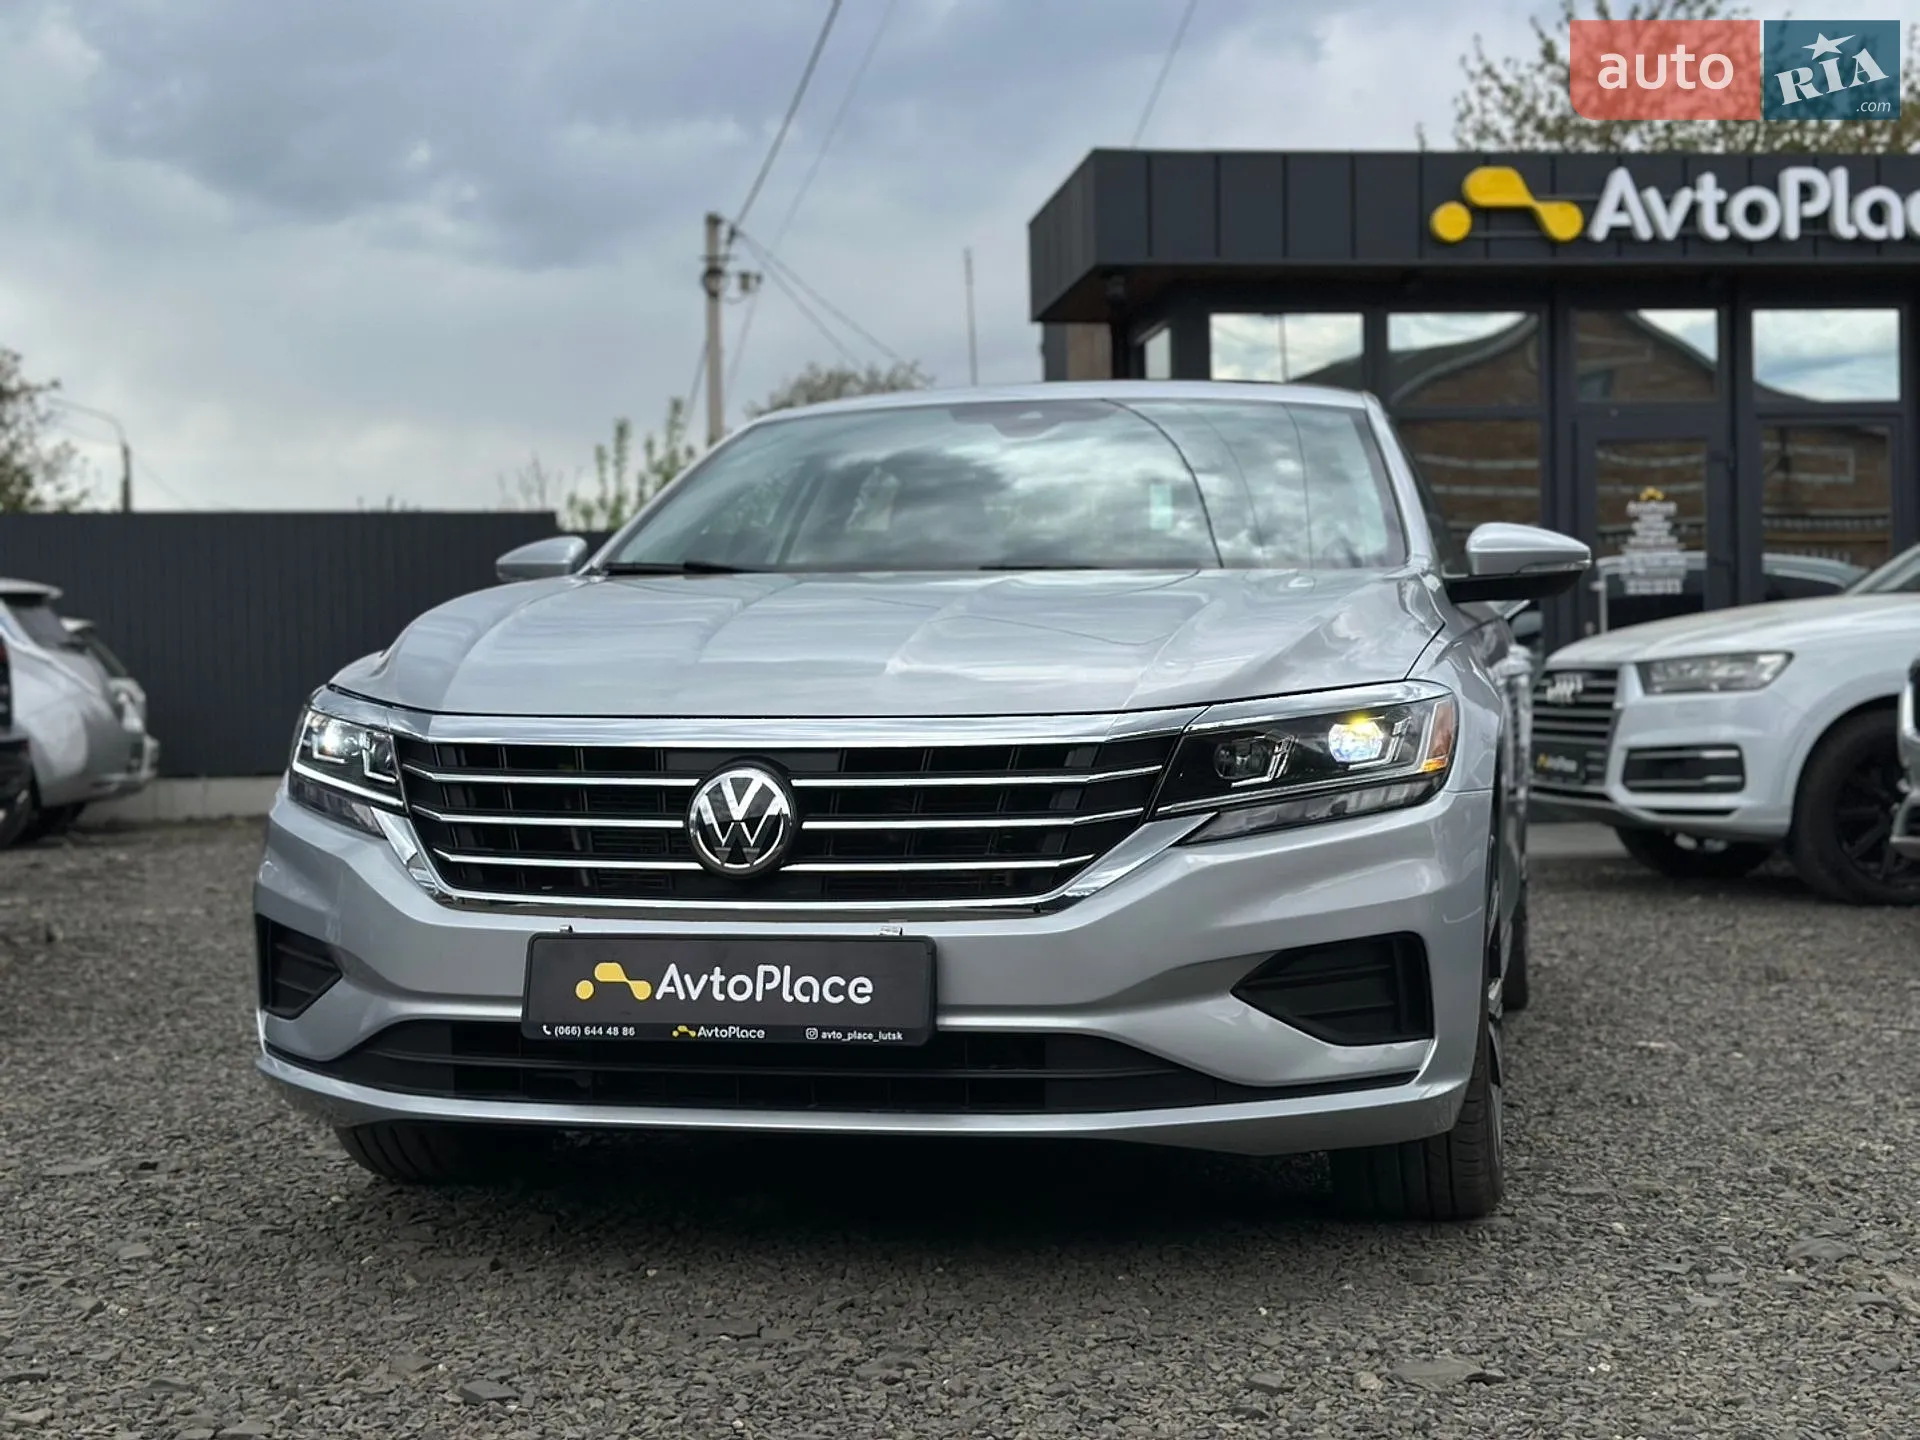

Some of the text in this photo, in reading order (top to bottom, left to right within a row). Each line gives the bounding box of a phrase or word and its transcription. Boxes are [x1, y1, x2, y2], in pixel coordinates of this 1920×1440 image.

[655, 962, 874, 1004] AvtoPlace
[554, 1025, 635, 1038] (066) 644 48 86
[697, 1025, 766, 1039] AvtoPlace
